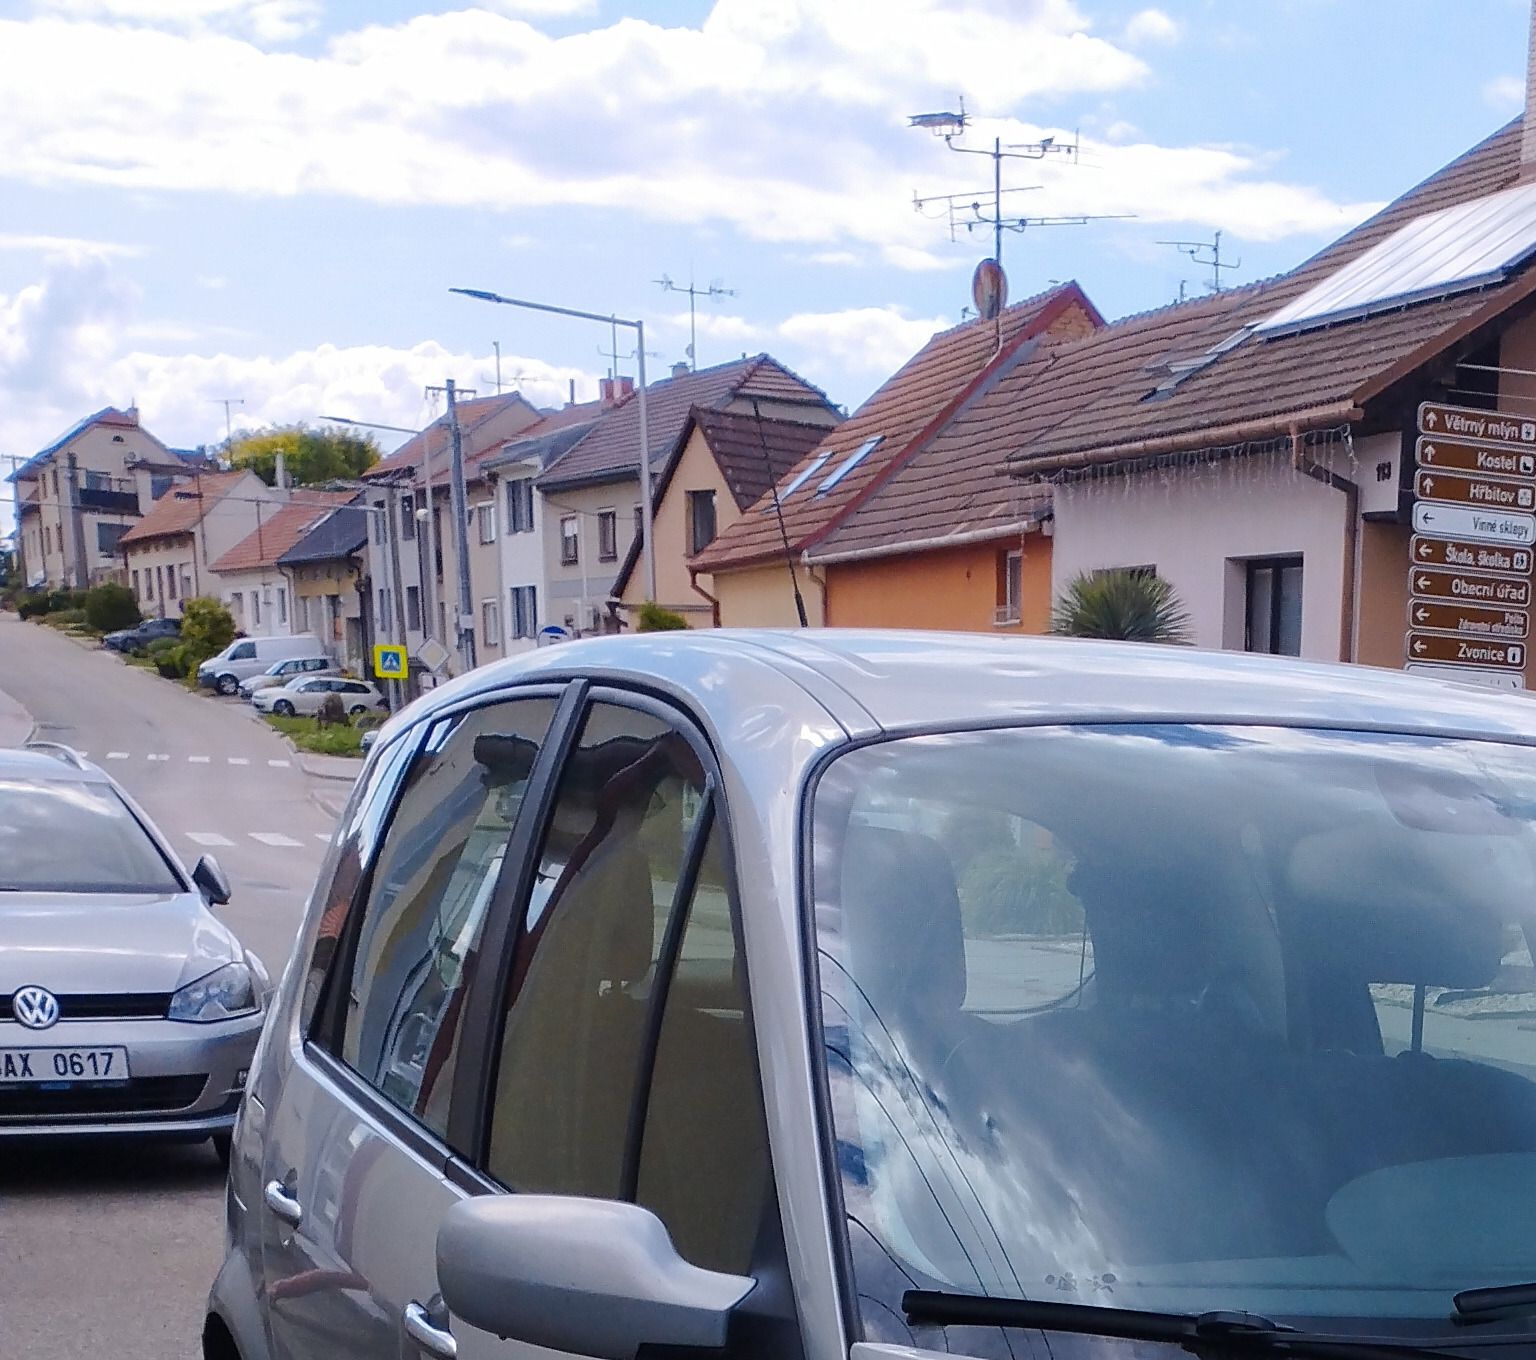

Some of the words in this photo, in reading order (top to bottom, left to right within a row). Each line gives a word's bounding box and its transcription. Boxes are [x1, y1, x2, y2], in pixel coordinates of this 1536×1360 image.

[1444, 413, 1486, 437] Větrný
[1488, 421, 1519, 439] mlýn
[1477, 451, 1516, 470] Kostel
[1469, 483, 1515, 503] Hřbitov
[1472, 515, 1497, 532] Vinné
[1452, 578, 1495, 597] Obecní
[1496, 583, 1526, 600] úřad
[1458, 642, 1505, 661] Zvonice
[0, 1053, 33, 1077] AX
[53, 1052, 114, 1076] 0617
